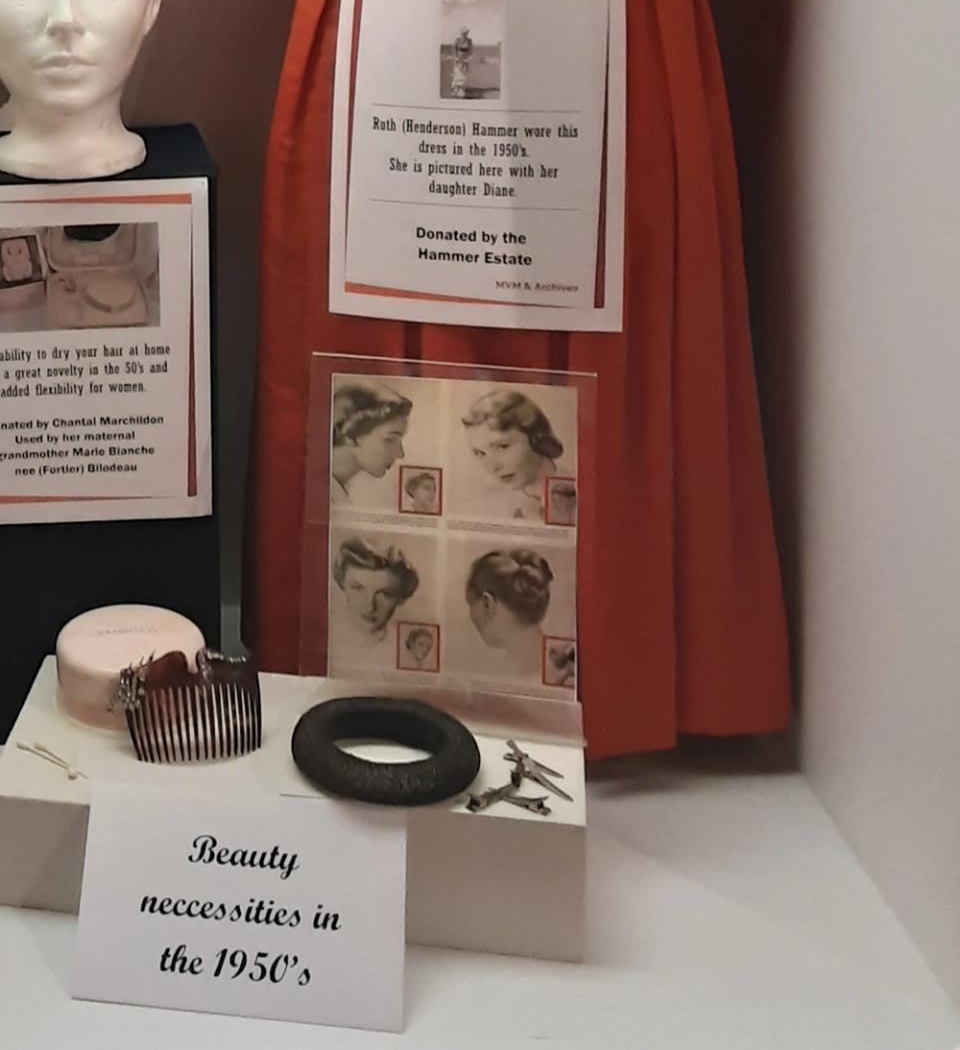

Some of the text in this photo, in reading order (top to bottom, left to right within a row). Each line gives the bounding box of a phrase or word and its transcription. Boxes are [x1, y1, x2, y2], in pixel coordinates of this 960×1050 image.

[373, 117, 578, 138] Ruth (Henderson) Hammer wore this
[419, 140, 446, 154] dress
[453, 145, 463, 155] in
[469, 143, 486, 156] the
[390, 157, 558, 178] She is pictured here with her
[429, 180, 517, 197] daughter Diane.
[416, 227, 526, 245] Donated by the
[419, 248, 532, 266] Hammer Estate
[496, 281, 578, 292] MVM & Archives
[0, 349, 31, 362] ability
[37, 350, 46, 359] to
[52, 347, 69, 361] dry
[75, 348, 97, 360] your
[103, 345, 123, 357] hair
[129, 345, 138, 356] at
[145, 343, 170, 355] home
[4, 371, 9, 379] a
[15, 368, 40, 381] great
[47, 364, 83, 378] novelty
[90, 366, 98, 375] in
[104, 363, 119, 374] the
[125, 361, 144, 374] 50's
[150, 361, 167, 373] and
[1, 384, 29, 397] added
[36, 383, 83, 396] flexibility
[90, 382, 103, 393] for
[36, 420, 49, 430] by
[52, 417, 96, 427] Chantal
[100, 416, 163, 425] Marchildon
[15, 431, 135, 444] Used by her maternal
[73, 447, 105, 457] Marie
[39, 465, 84, 476] (Fortier)
[88, 463, 137, 473] Bilodeau
[188, 836, 299, 879] Beauty
[141, 896, 339, 931] neccessities in
[160, 945, 310, 985] the 1950's
